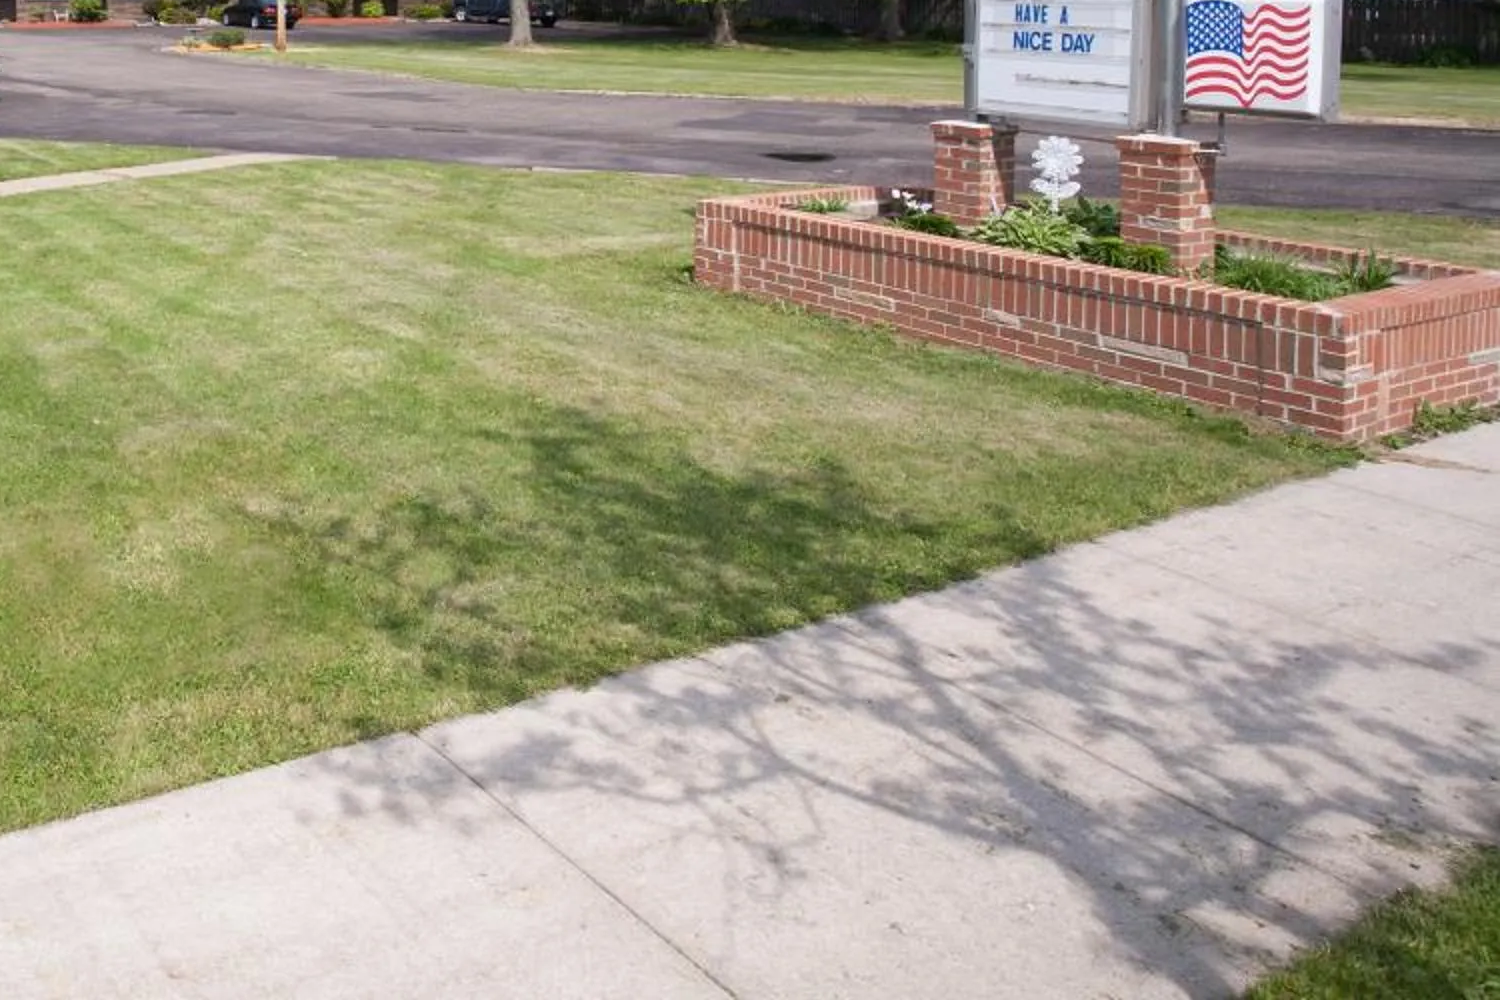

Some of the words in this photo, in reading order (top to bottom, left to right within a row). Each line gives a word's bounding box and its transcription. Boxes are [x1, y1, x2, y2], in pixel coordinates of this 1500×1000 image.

[1015, 4, 1049, 23] HAVE
[1059, 5, 1069, 24] A
[1013, 31, 1053, 51] NICE
[1061, 33, 1095, 52] DAY
